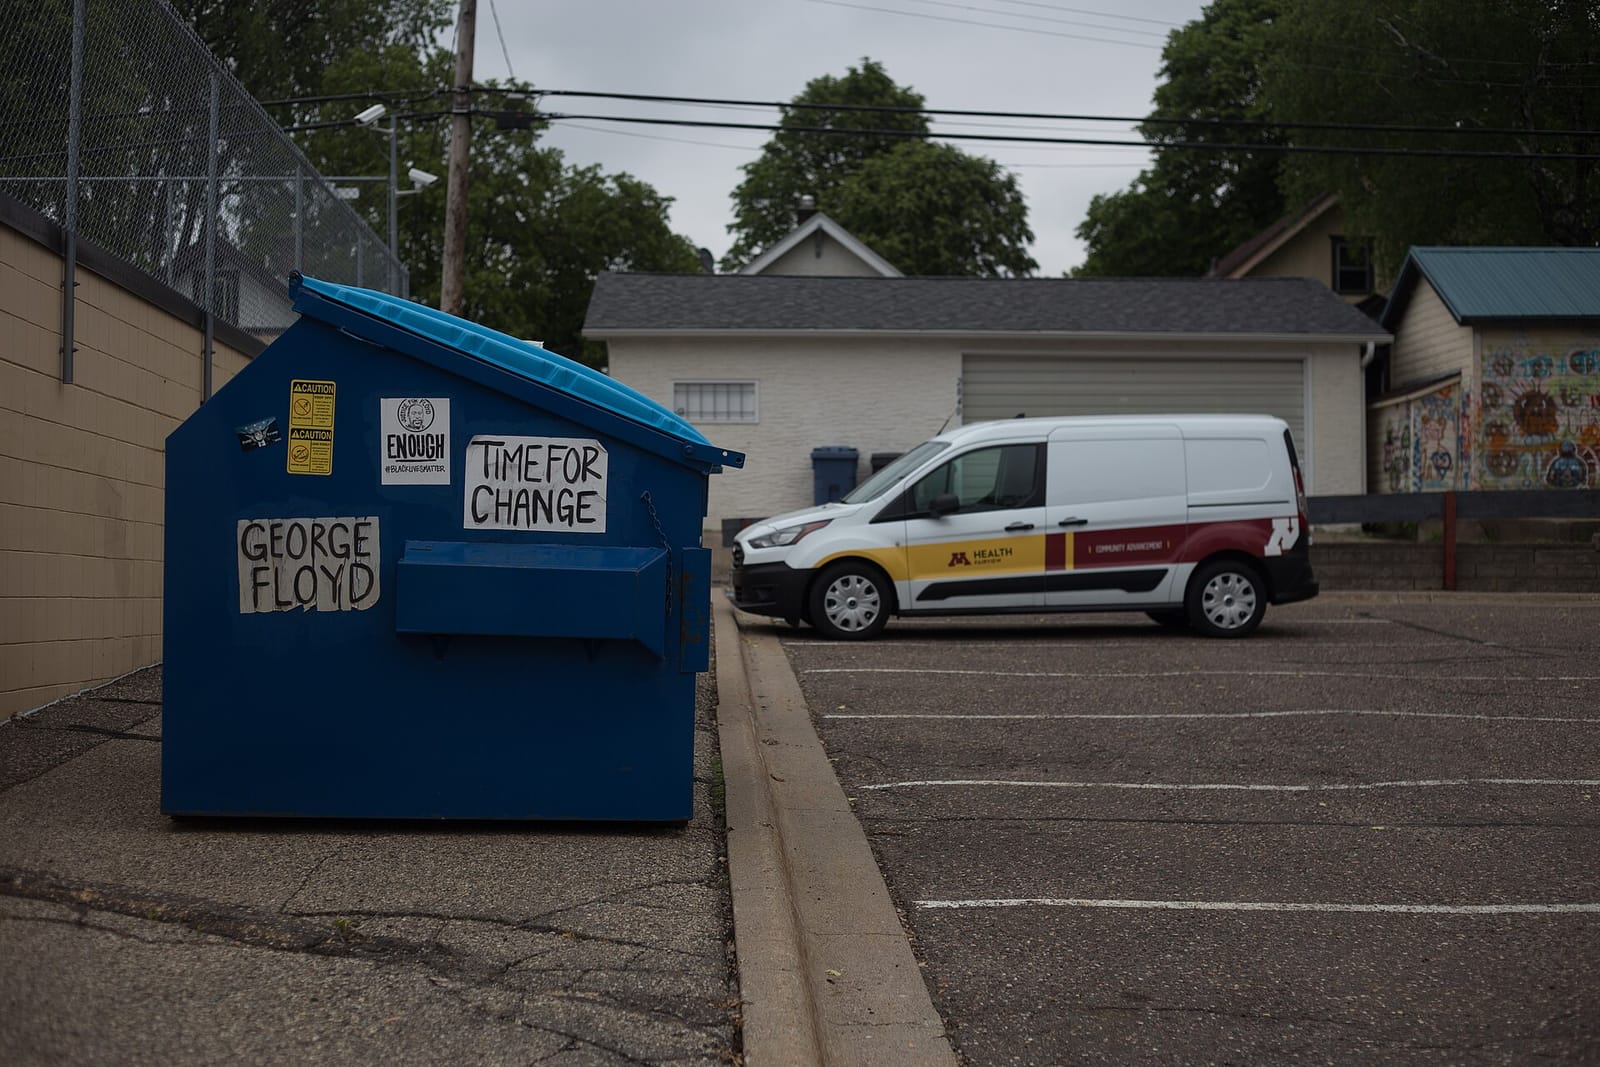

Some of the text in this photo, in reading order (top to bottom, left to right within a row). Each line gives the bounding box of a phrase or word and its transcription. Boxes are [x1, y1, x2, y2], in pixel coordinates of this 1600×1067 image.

[301, 384, 334, 394] CAUTION
[400, 402, 410, 422] JUSTICE
[419, 399, 431, 415] FLOYD
[299, 430, 332, 440] CAUTION
[387, 434, 444, 459] ENOUGH
[385, 465, 446, 473] #BLACKLIVESMATTER
[471, 441, 602, 484] TIME FOR
[471, 485, 599, 528] CHANGE
[241, 521, 372, 562] GEORGE
[974, 547, 1013, 559] HEALTH
[1095, 540, 1163, 553] COMMUNITY ADVANCEMENT
[252, 562, 375, 609] FLOYD
